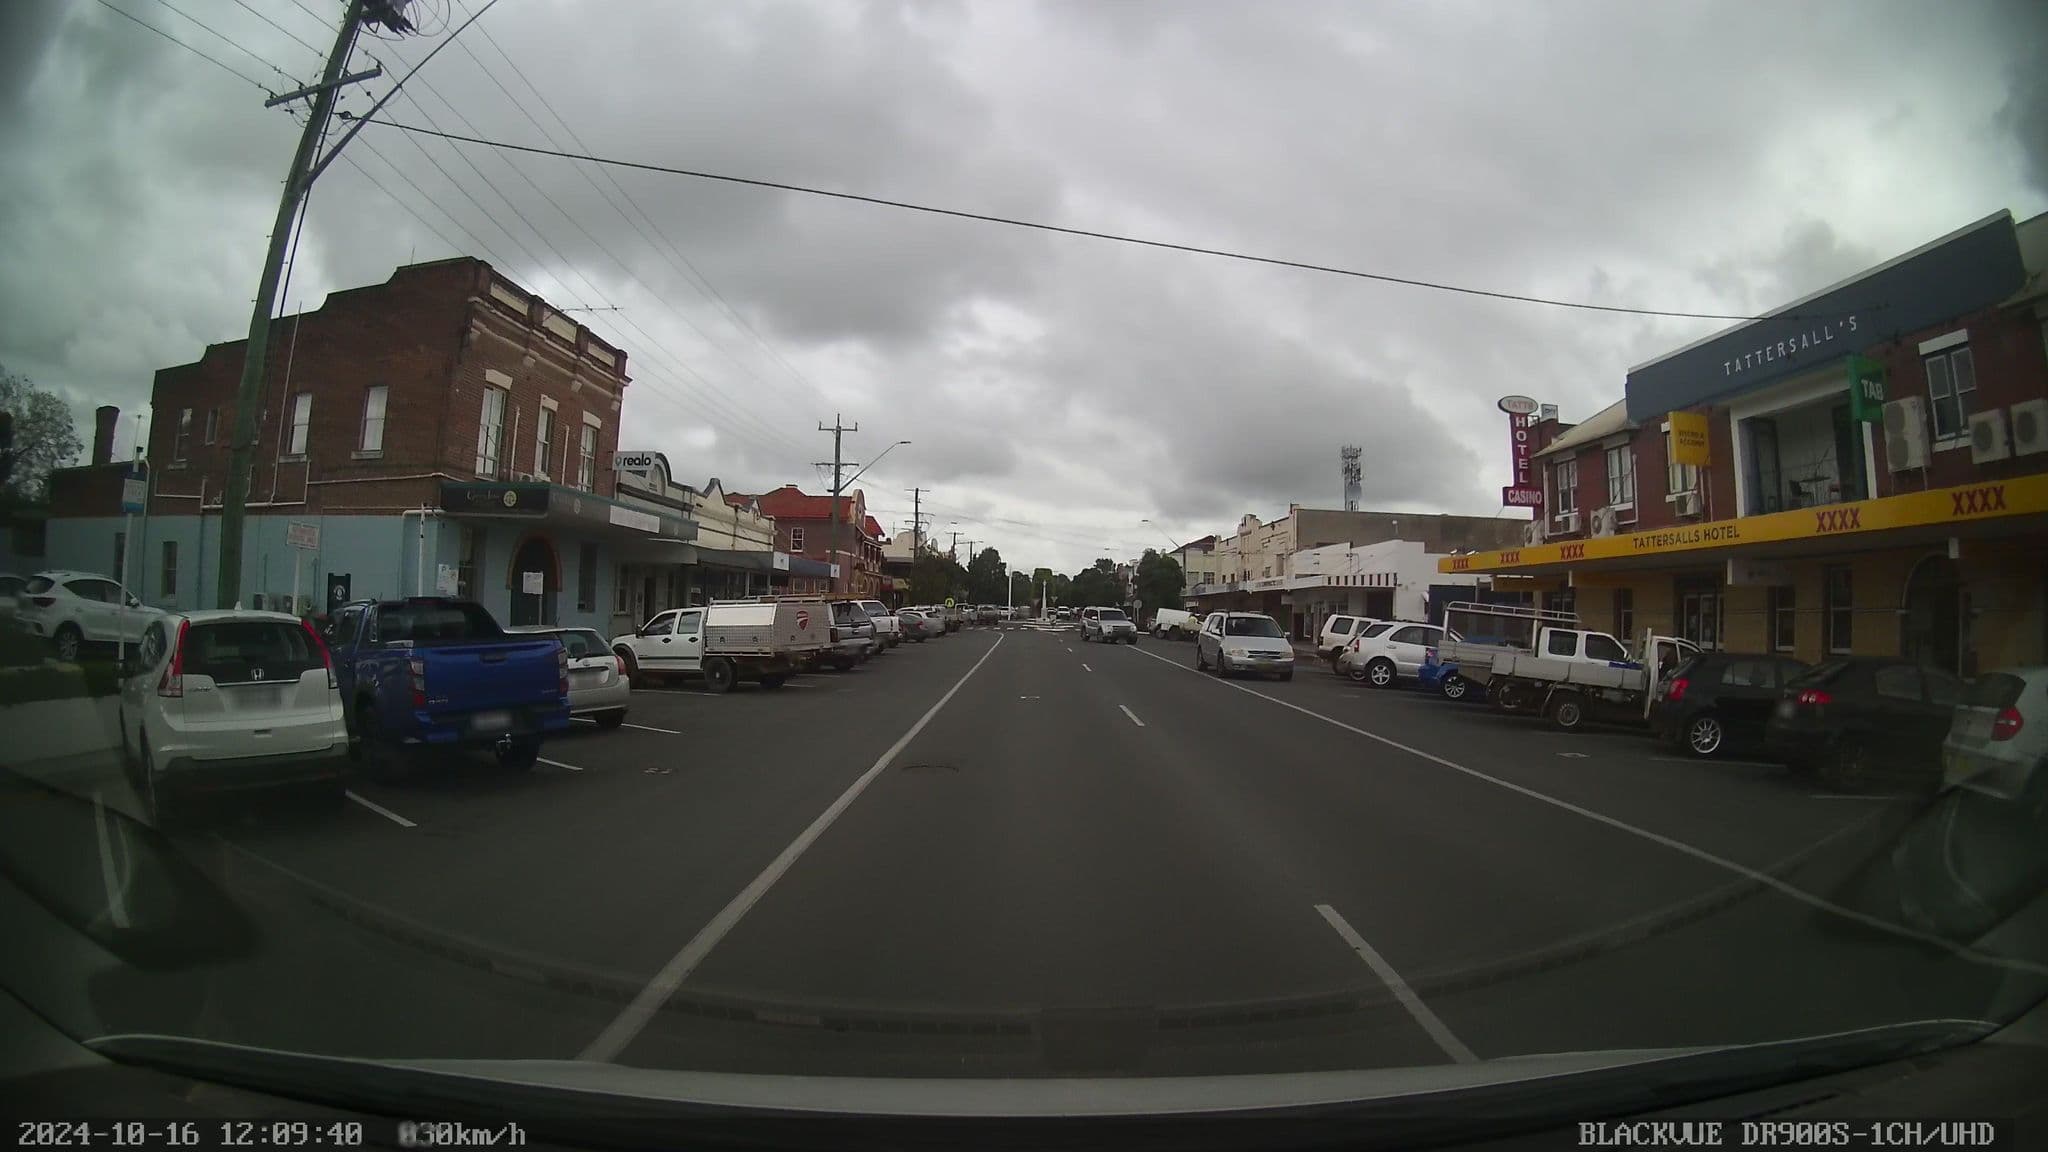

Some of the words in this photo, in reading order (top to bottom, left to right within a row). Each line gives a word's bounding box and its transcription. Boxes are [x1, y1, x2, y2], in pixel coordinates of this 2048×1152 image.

[1724, 315, 1857, 376] TATTERSALL'S
[1861, 378, 1884, 401] TAB
[623, 453, 652, 467] realo
[1515, 417, 1529, 484] HOTEL
[1508, 490, 1543, 505] CASINO
[1951, 485, 2007, 517] XXXX
[1815, 507, 1862, 534] XXXX
[1632, 530, 1700, 549] TATTERSALLS
[1703, 525, 1740, 542] HOTEL
[1452, 557, 1469, 570] XXXX
[1500, 550, 1520, 565] XXXX
[1560, 543, 1584, 561] XXXX
